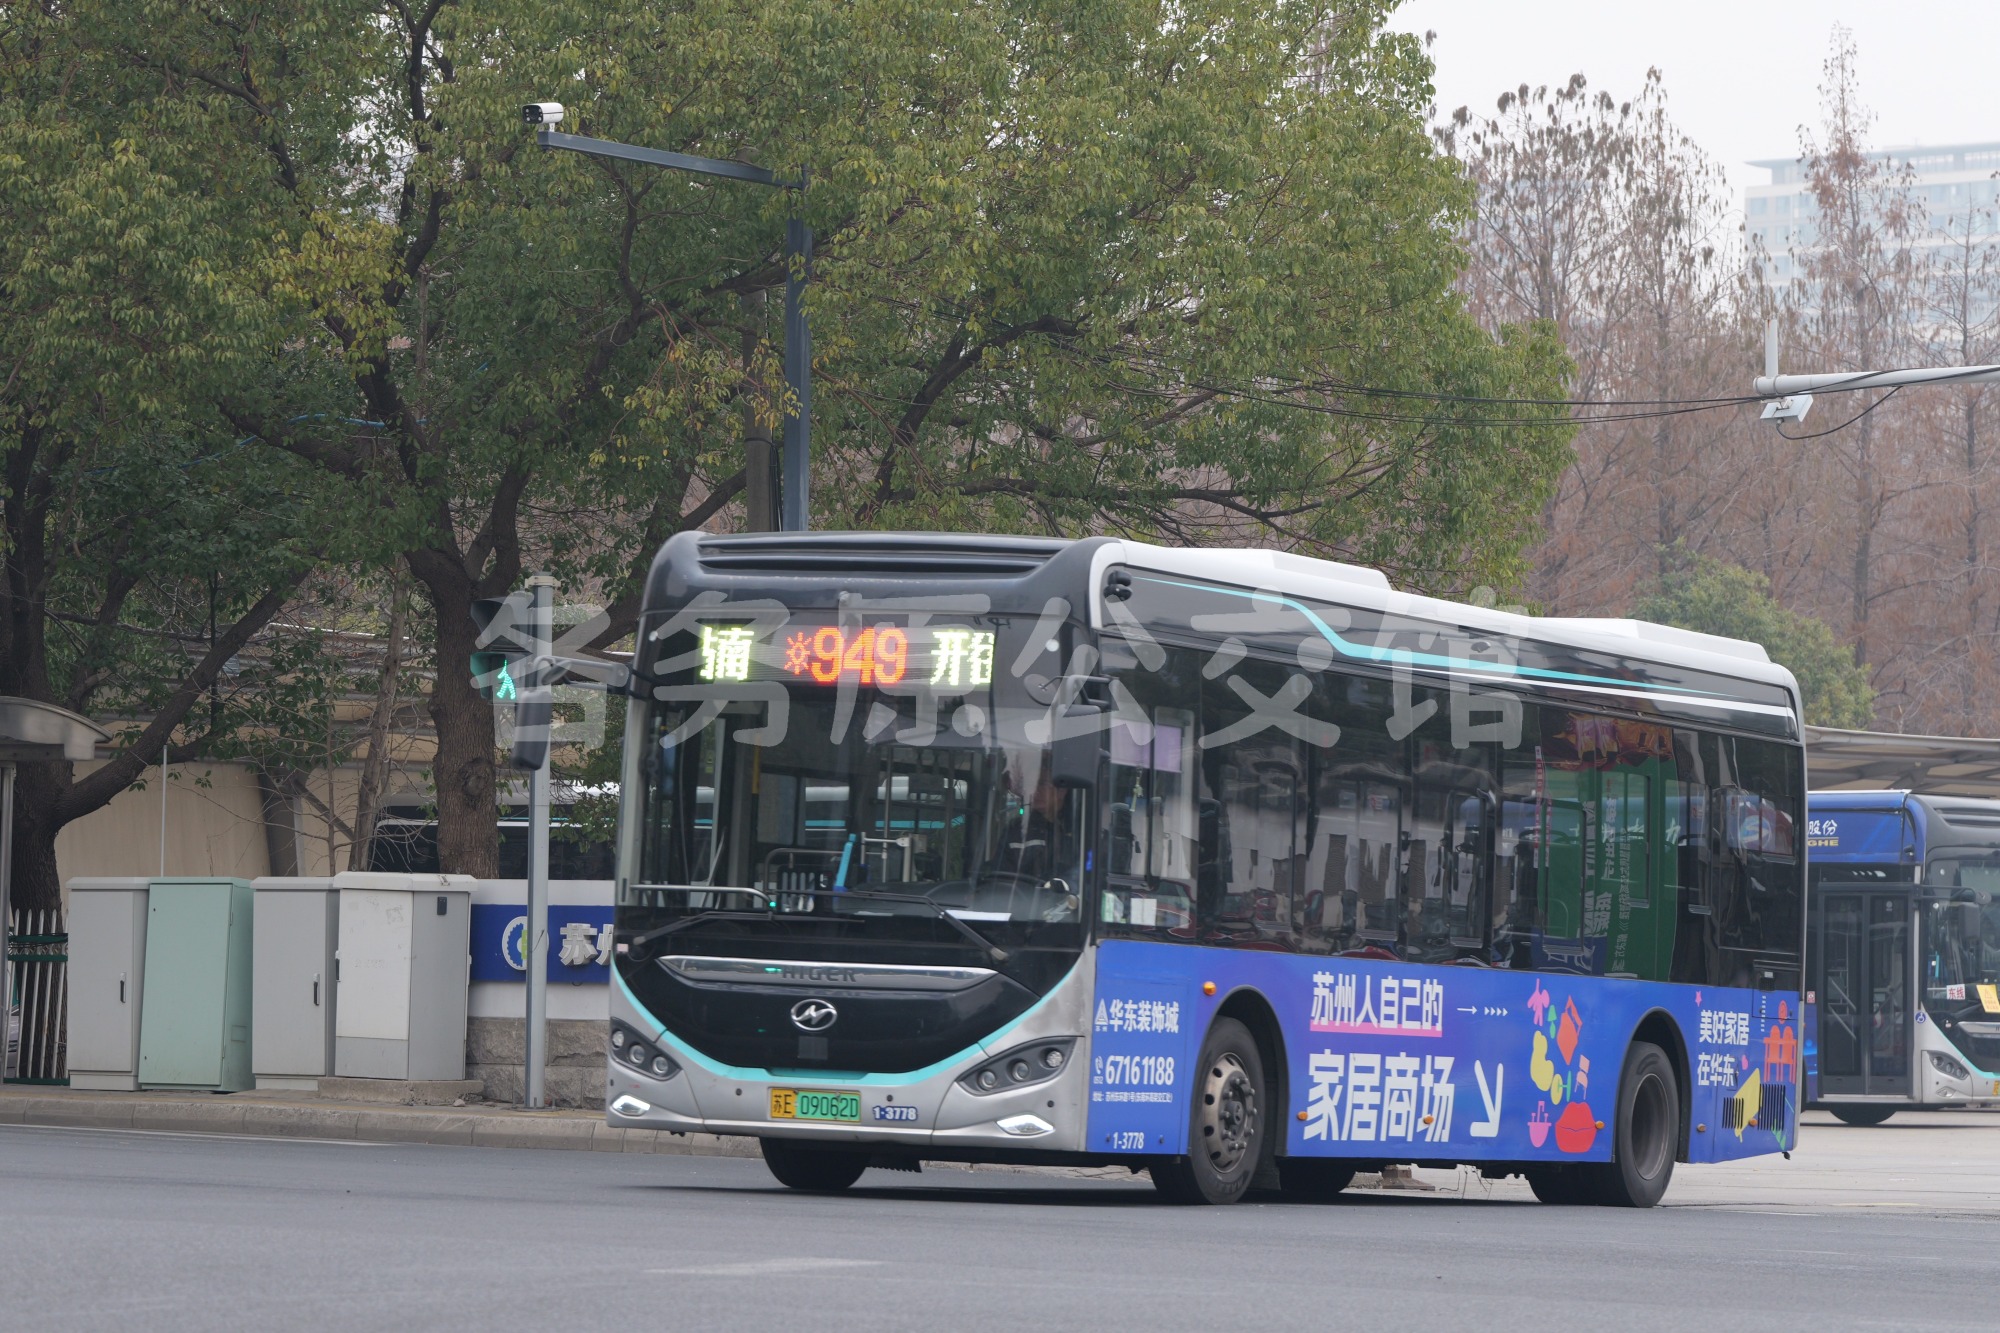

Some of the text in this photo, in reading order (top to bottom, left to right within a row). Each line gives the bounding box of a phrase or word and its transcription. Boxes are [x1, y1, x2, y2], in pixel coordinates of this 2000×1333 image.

[810, 627, 907, 683] 949
[781, 964, 857, 983] HIGER
[1109, 998, 1180, 1034] 华东装饰城
[1311, 971, 1443, 1031] 苏州人自己的
[1699, 1009, 1750, 1046] 美好家居
[1105, 1055, 1175, 1086] 67161188
[1697, 1051, 1736, 1088] 在华东
[800, 1095, 859, 1118] 09062D
[1303, 1049, 1455, 1142] 家居商场
[1112, 1131, 1145, 1150] 1-3778
